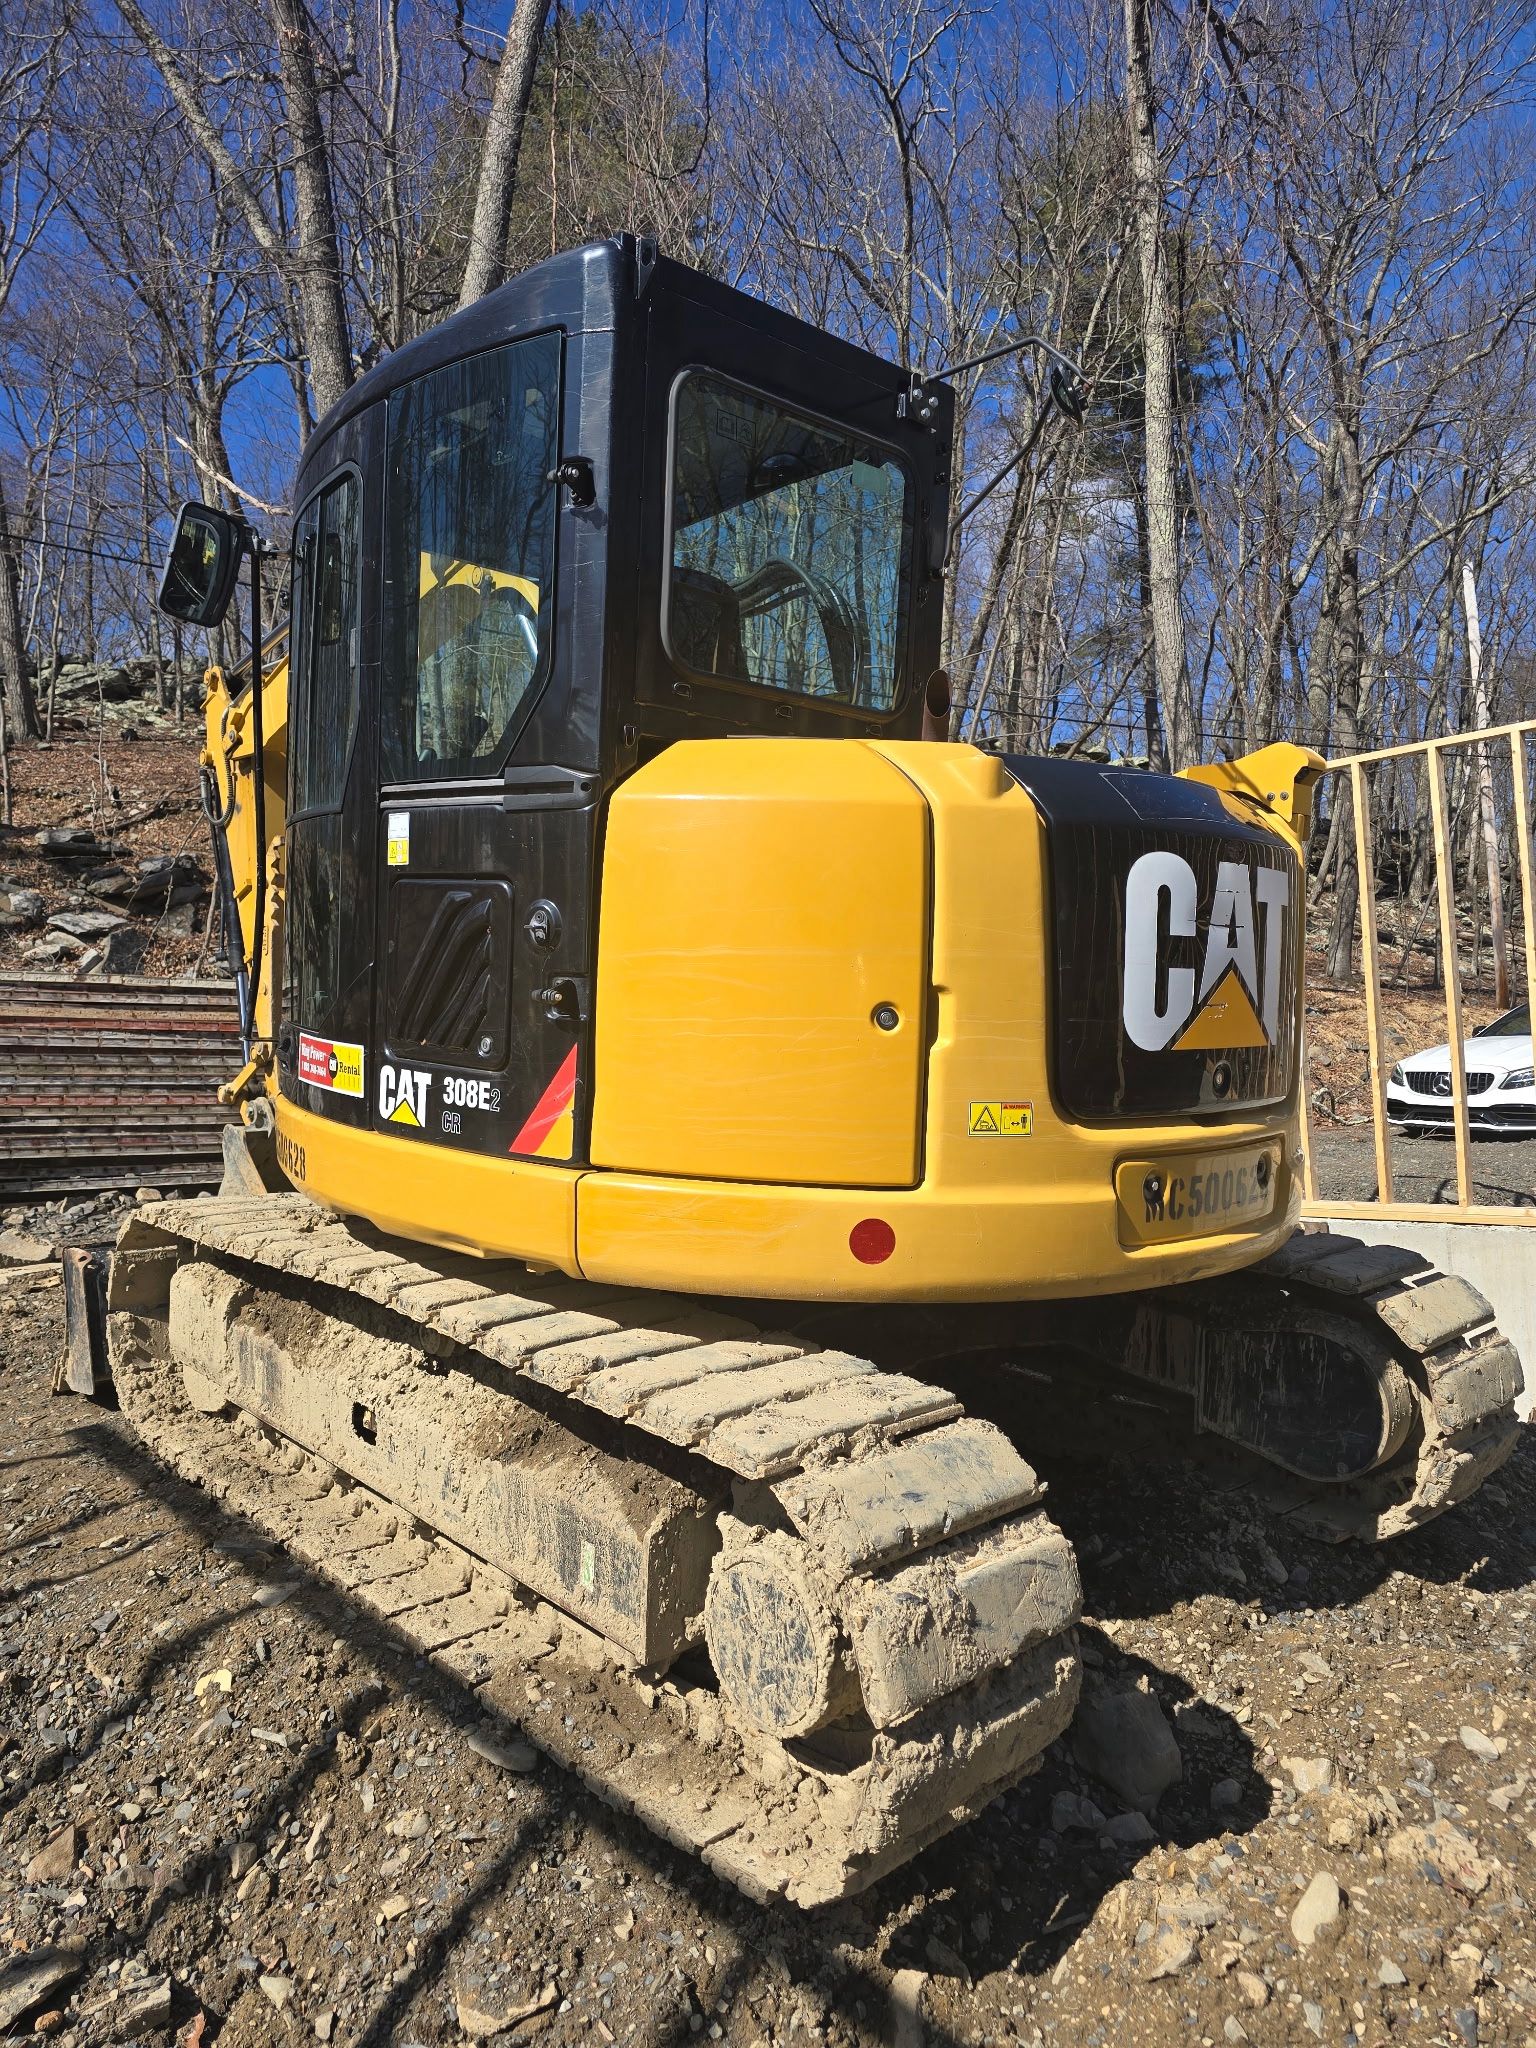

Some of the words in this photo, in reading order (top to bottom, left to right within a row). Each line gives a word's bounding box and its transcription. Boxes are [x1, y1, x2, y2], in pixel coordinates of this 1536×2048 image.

[1123, 851, 1289, 1051] CAT
[310, 1045, 326, 1062] Power
[339, 1061, 360, 1076] Rental
[379, 1065, 432, 1128] CAT
[442, 1111, 461, 1134] CR
